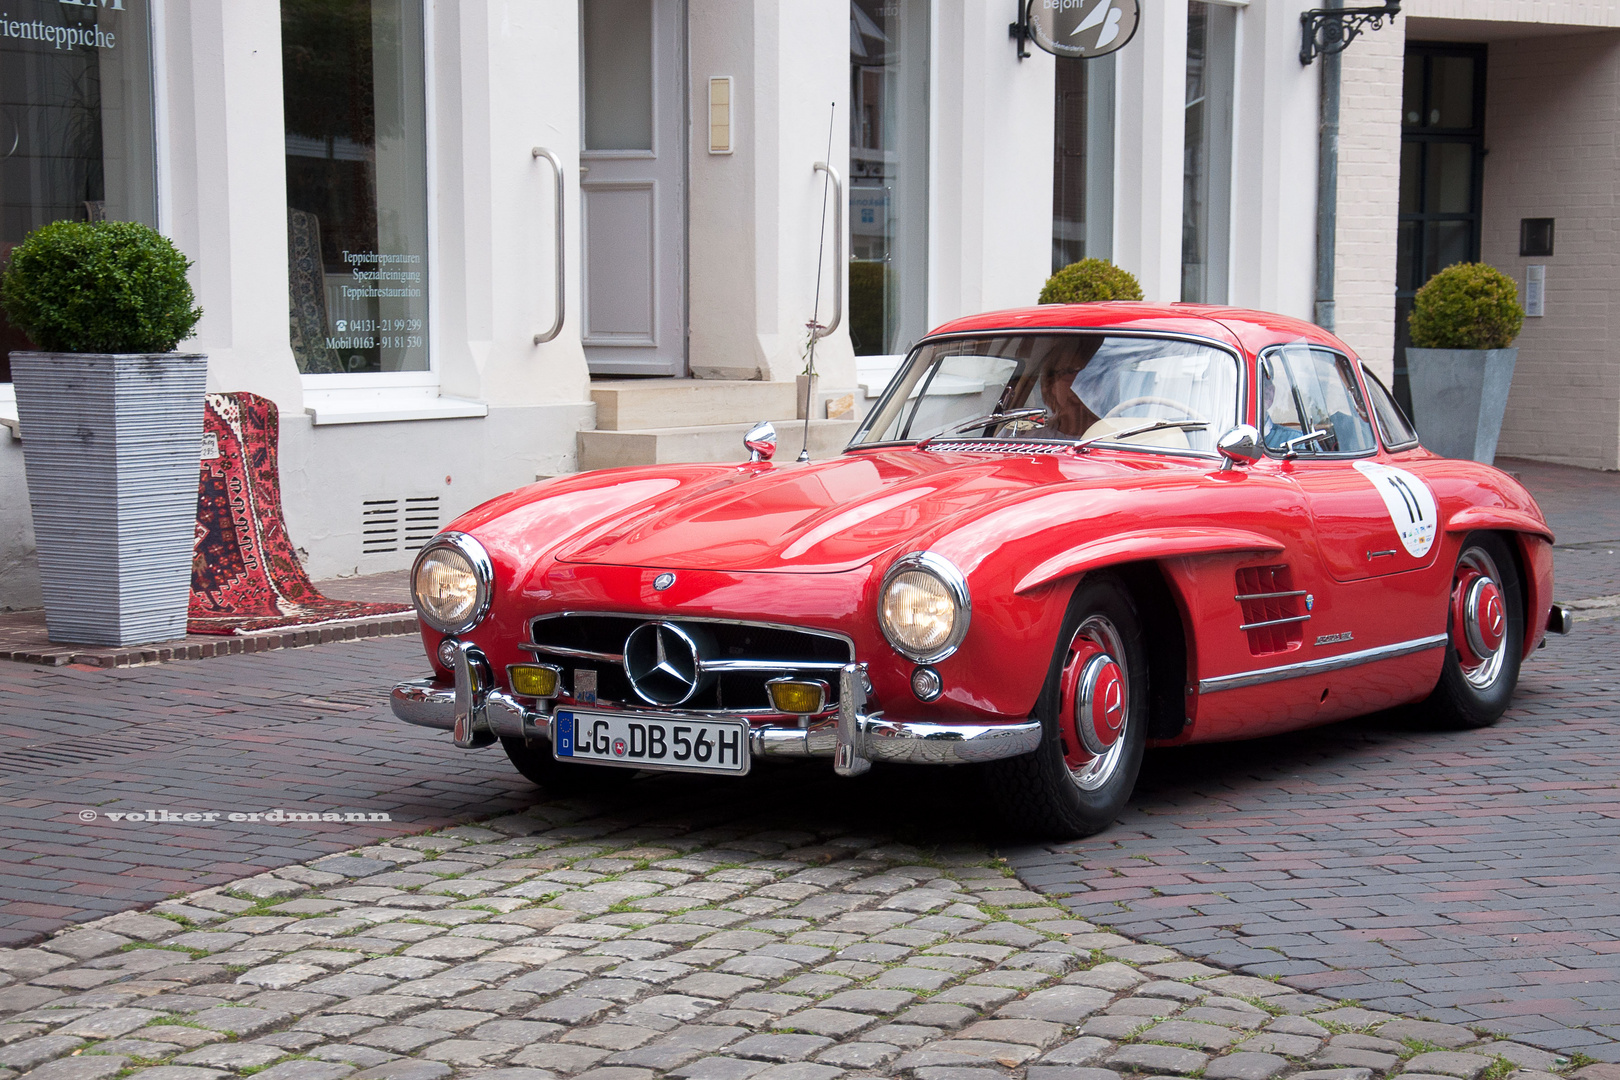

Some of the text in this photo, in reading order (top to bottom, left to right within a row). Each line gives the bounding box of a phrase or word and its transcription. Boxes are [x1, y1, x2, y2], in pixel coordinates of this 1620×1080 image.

[342, 250, 421, 266] Teppichreparaturen
[352, 268, 421, 283] Spezialreinigung
[341, 285, 421, 301] Teppichrestauration
[350, 319, 375, 332] 04131
[382, 319, 392, 331] 21
[394, 319, 405, 330] 99
[406, 319, 422, 331] 299
[326, 337, 351, 350] Mobil
[353, 337, 375, 349] 0163
[382, 336, 392, 348] 91
[394, 336, 404, 348] 81
[406, 336, 422, 348] 530
[1387, 475, 1424, 524] 11
[562, 738, 569, 748] D
[574, 718, 610, 755] LG
